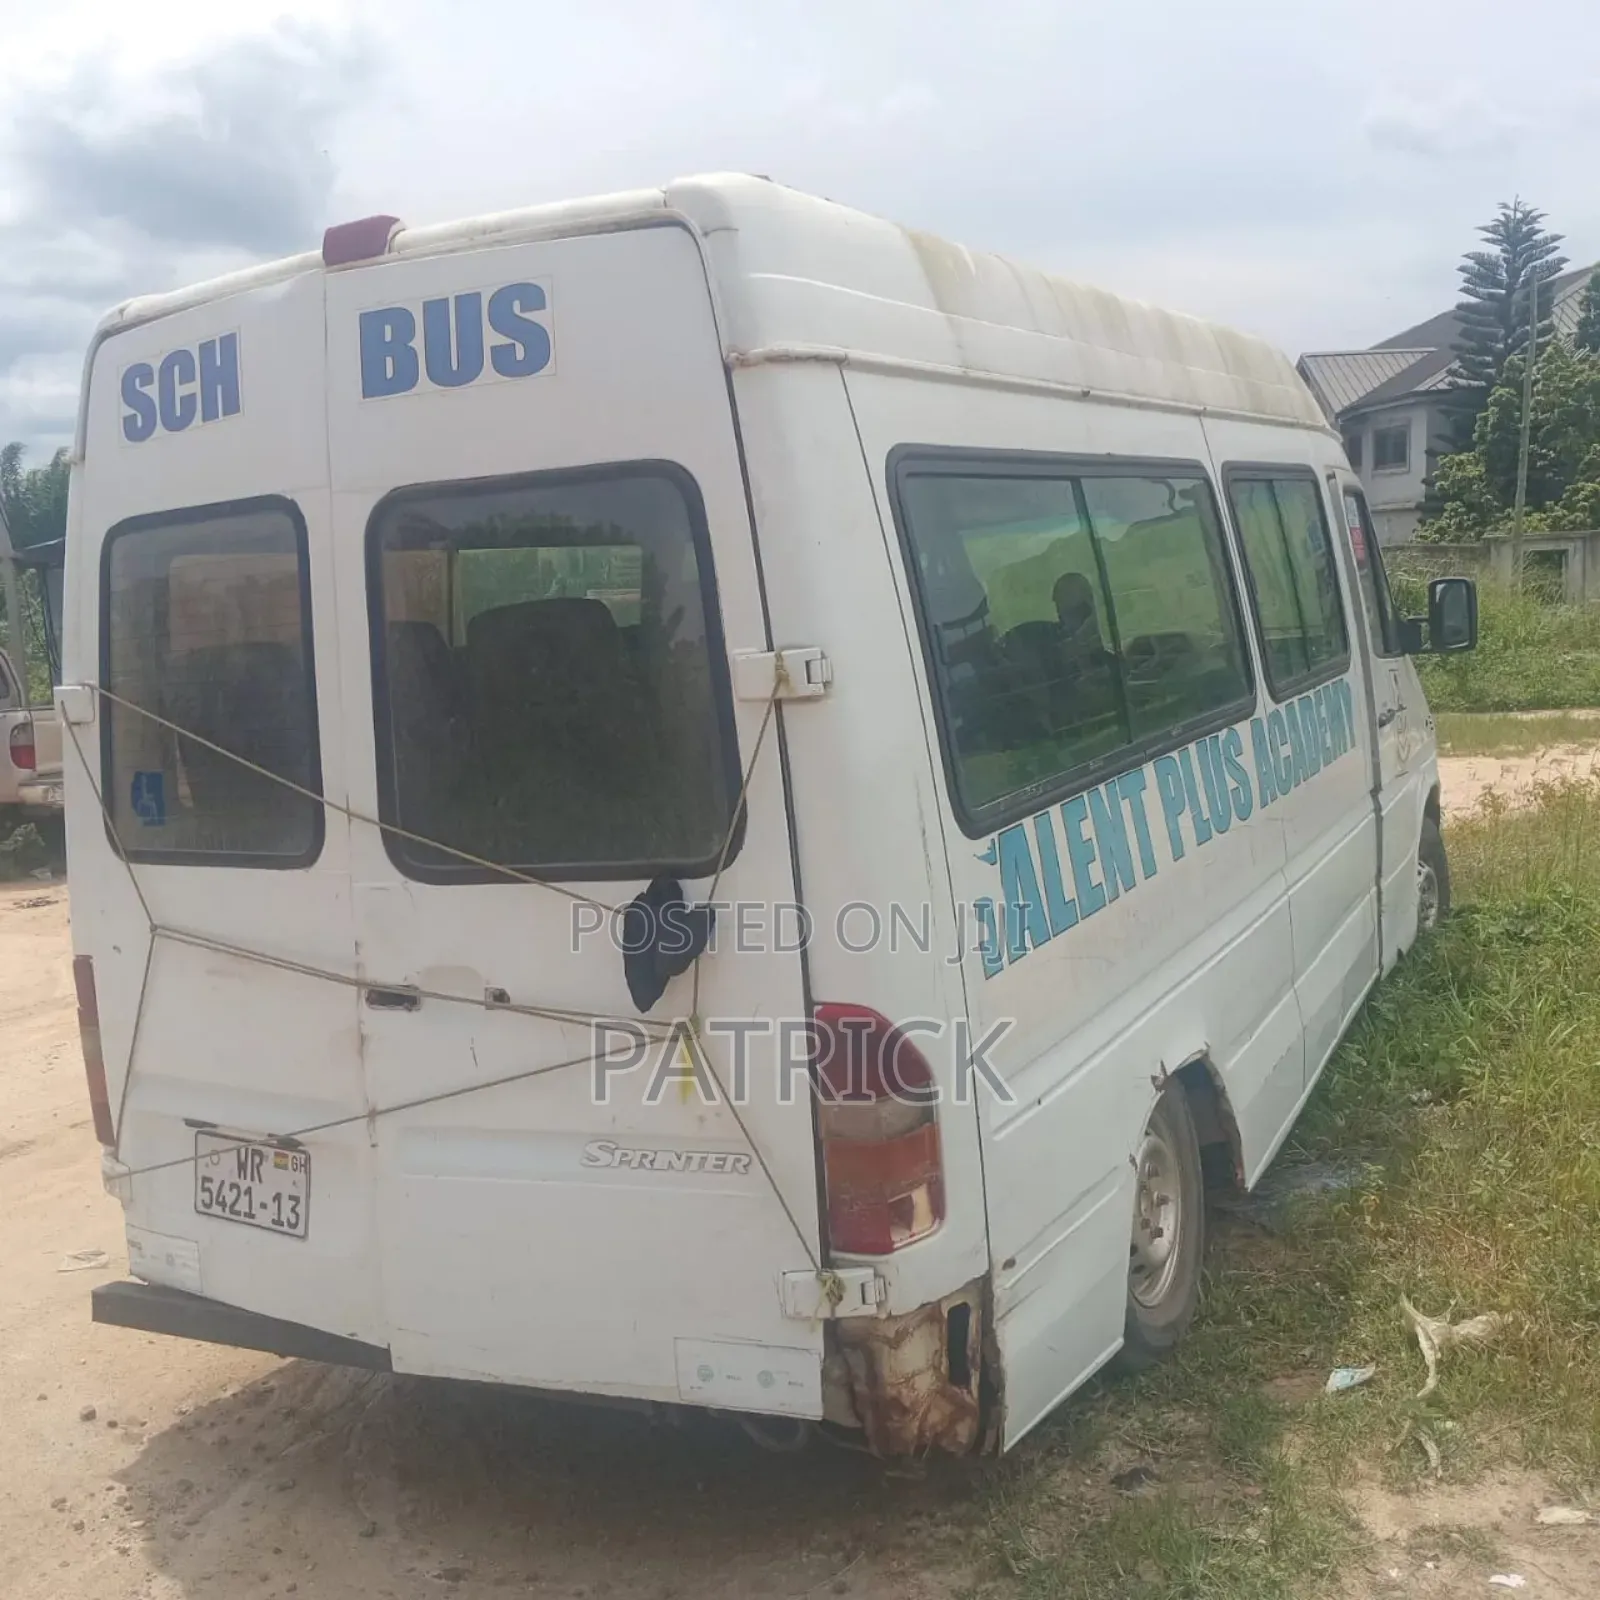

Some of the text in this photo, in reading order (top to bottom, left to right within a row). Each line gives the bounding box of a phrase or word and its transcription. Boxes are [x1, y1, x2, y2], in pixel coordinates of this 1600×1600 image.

[120, 282, 552, 443] SCH BUS
[1154, 727, 1253, 862] PLUS
[1250, 678, 1357, 809] ACADEMY
[236, 1146, 308, 1185] WR GH
[580, 1140, 752, 1175] SPRINTER
[200, 1174, 301, 1230] 5421-13
